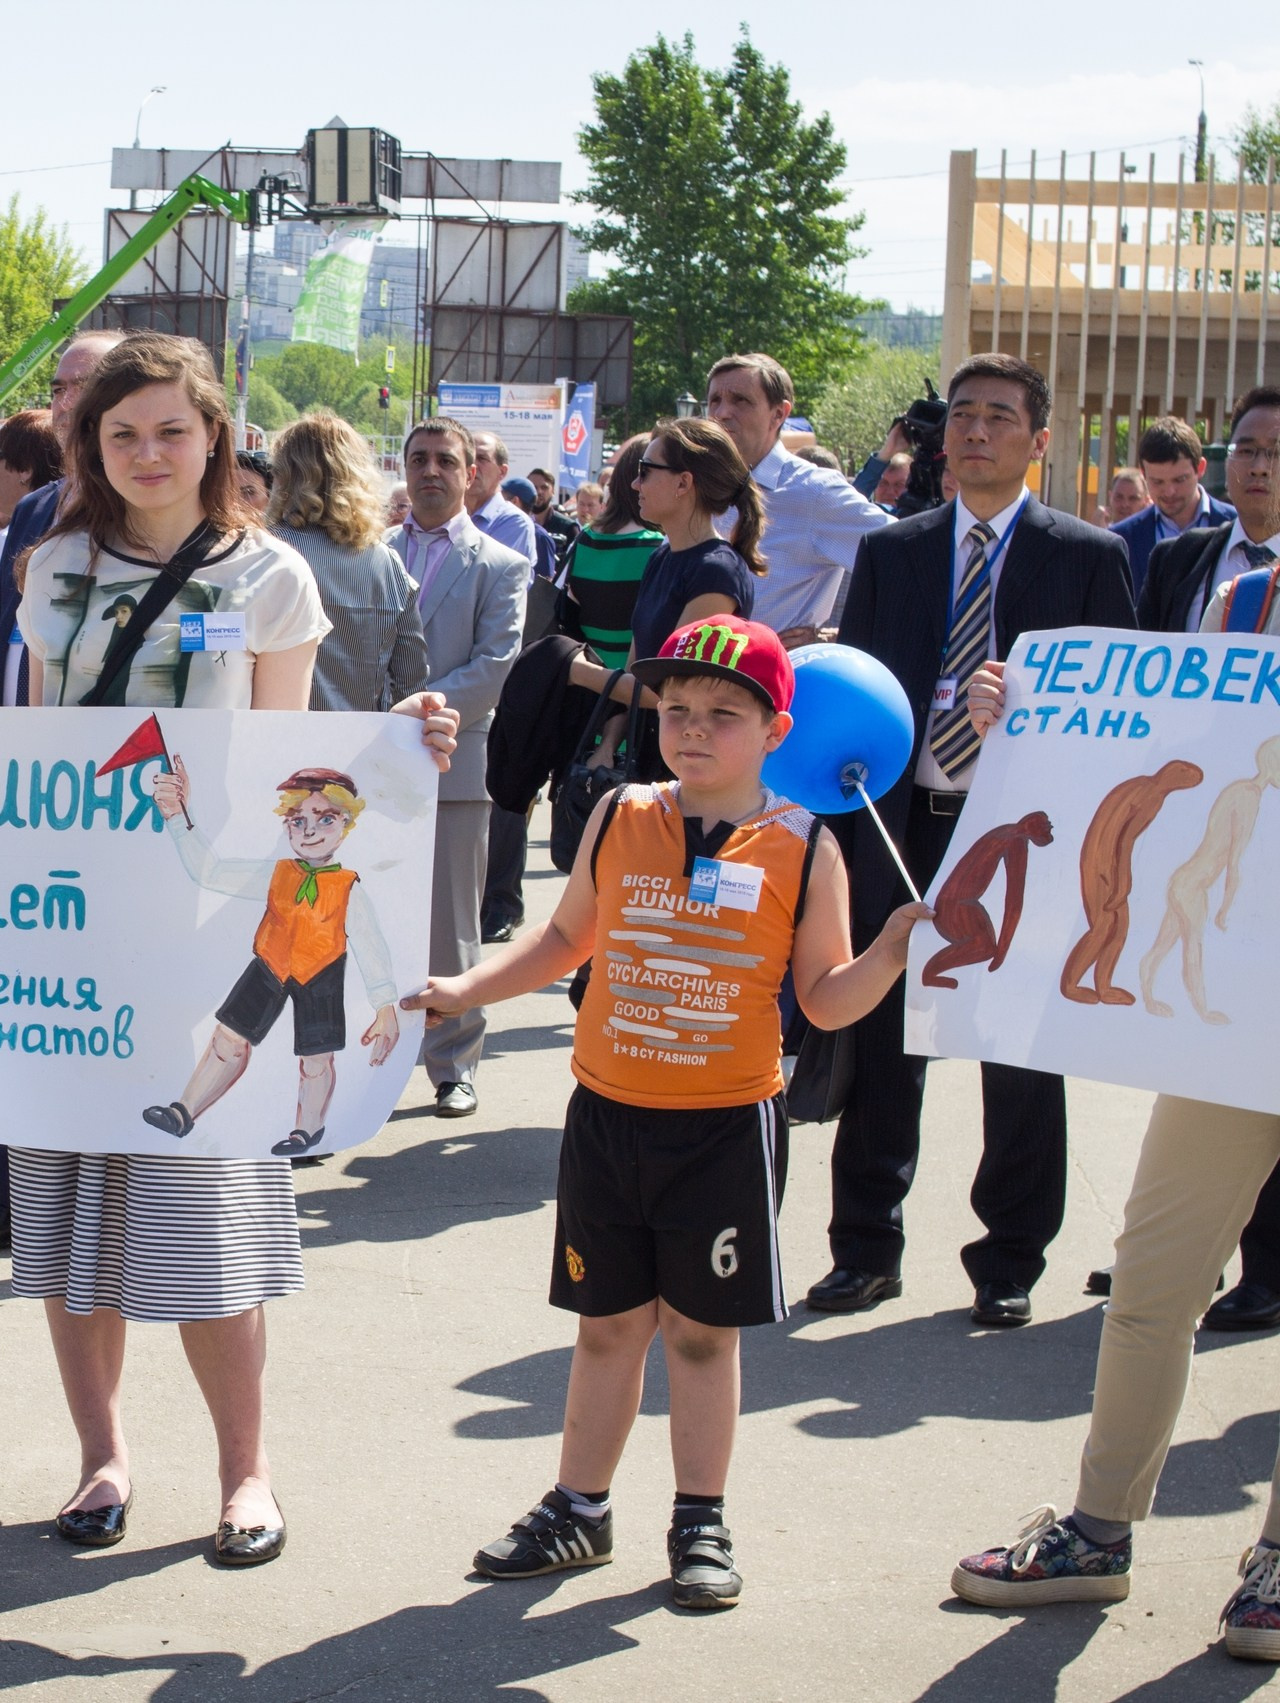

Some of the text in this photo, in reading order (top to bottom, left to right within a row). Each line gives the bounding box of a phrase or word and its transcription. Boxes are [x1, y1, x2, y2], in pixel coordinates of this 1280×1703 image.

[504, 411, 530, 420] 15-18
[1023, 640, 1280, 706] ЧЕЛОВЕК
[934, 689, 952, 700] VIP
[1006, 706, 1151, 740] СТАНЬ
[622, 873, 671, 891] BICCI
[720, 879, 757, 891] КОНГРЕСС
[627, 889, 720, 919] JUNIOR
[614, 1001, 660, 1021] GOOD
[680, 993, 728, 1011] PARIS
[692, 1034, 708, 1043] GO
[657, 1051, 707, 1066] FASHION
[711, 1227, 738, 1278] 6
